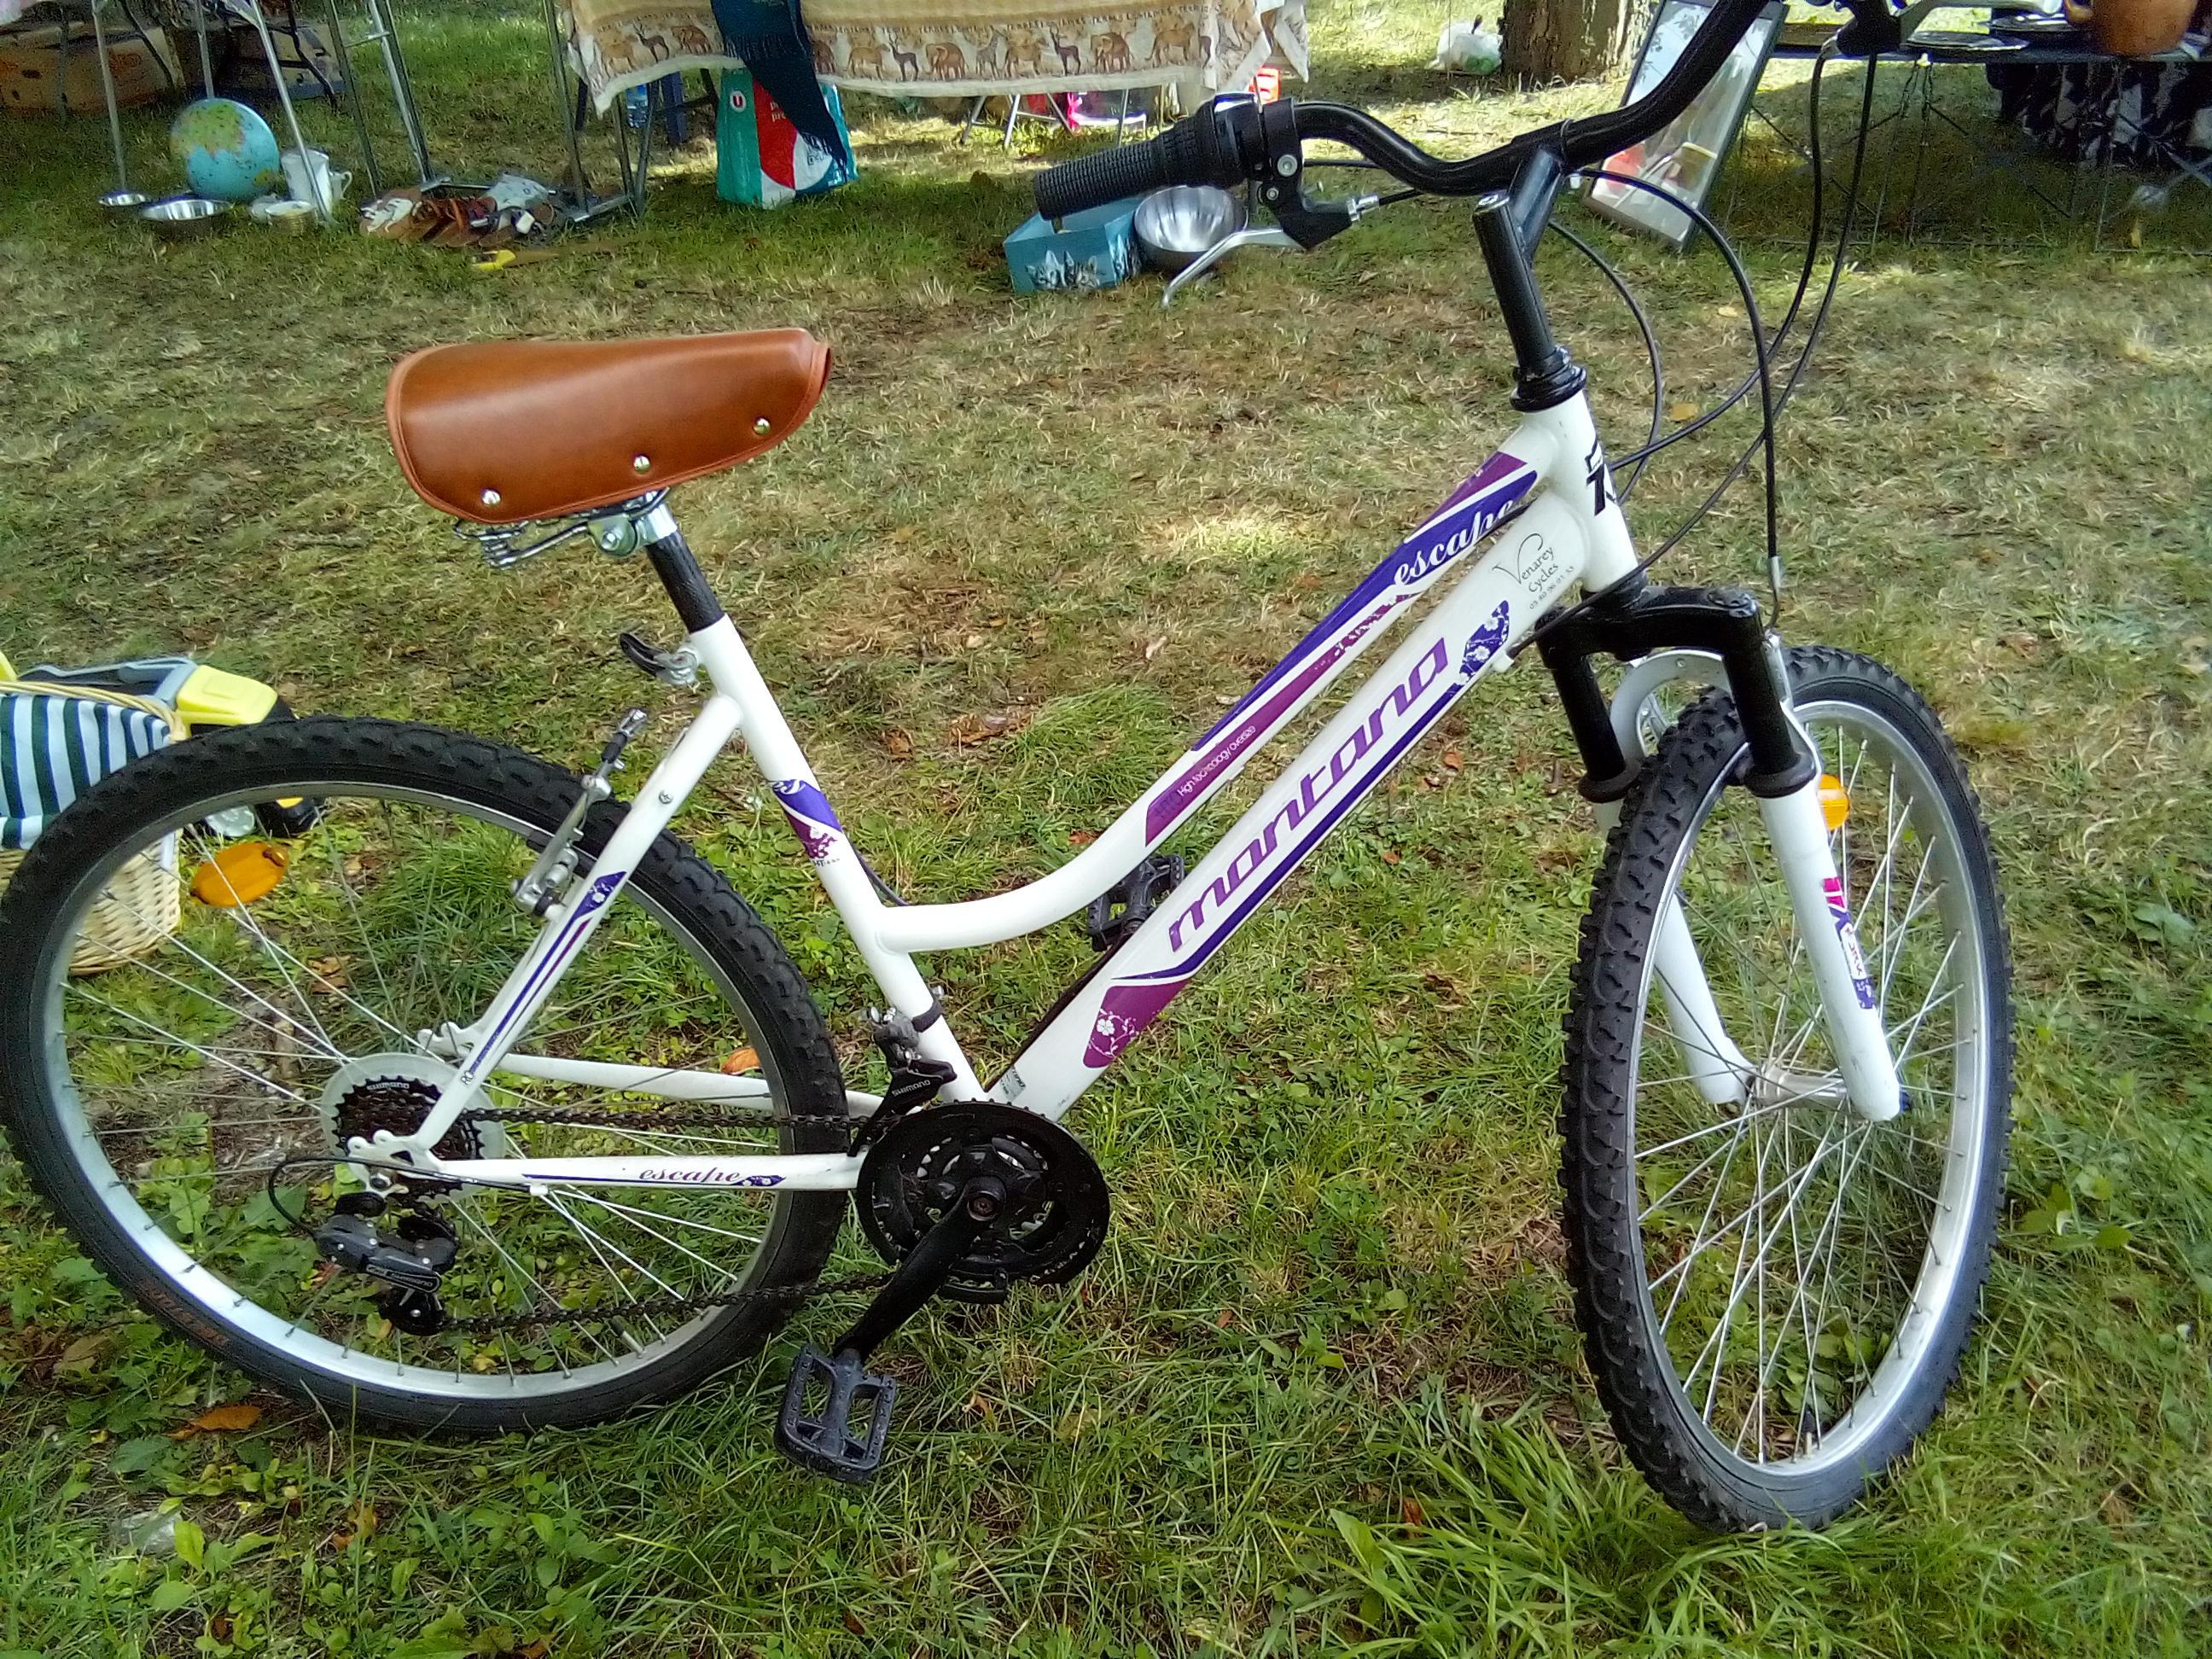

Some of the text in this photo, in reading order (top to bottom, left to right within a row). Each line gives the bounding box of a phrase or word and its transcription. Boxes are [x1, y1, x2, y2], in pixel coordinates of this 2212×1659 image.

[732, 95, 743, 107] U
[1392, 498, 1514, 590] escape
[1492, 533, 1555, 585] Venarey
[1528, 563, 1558, 593] Cycles
[1168, 637, 1448, 953] montana
[1177, 780, 1196, 797] High
[891, 1079, 931, 1097] SHIMANO
[638, 1166, 742, 1185] escape
